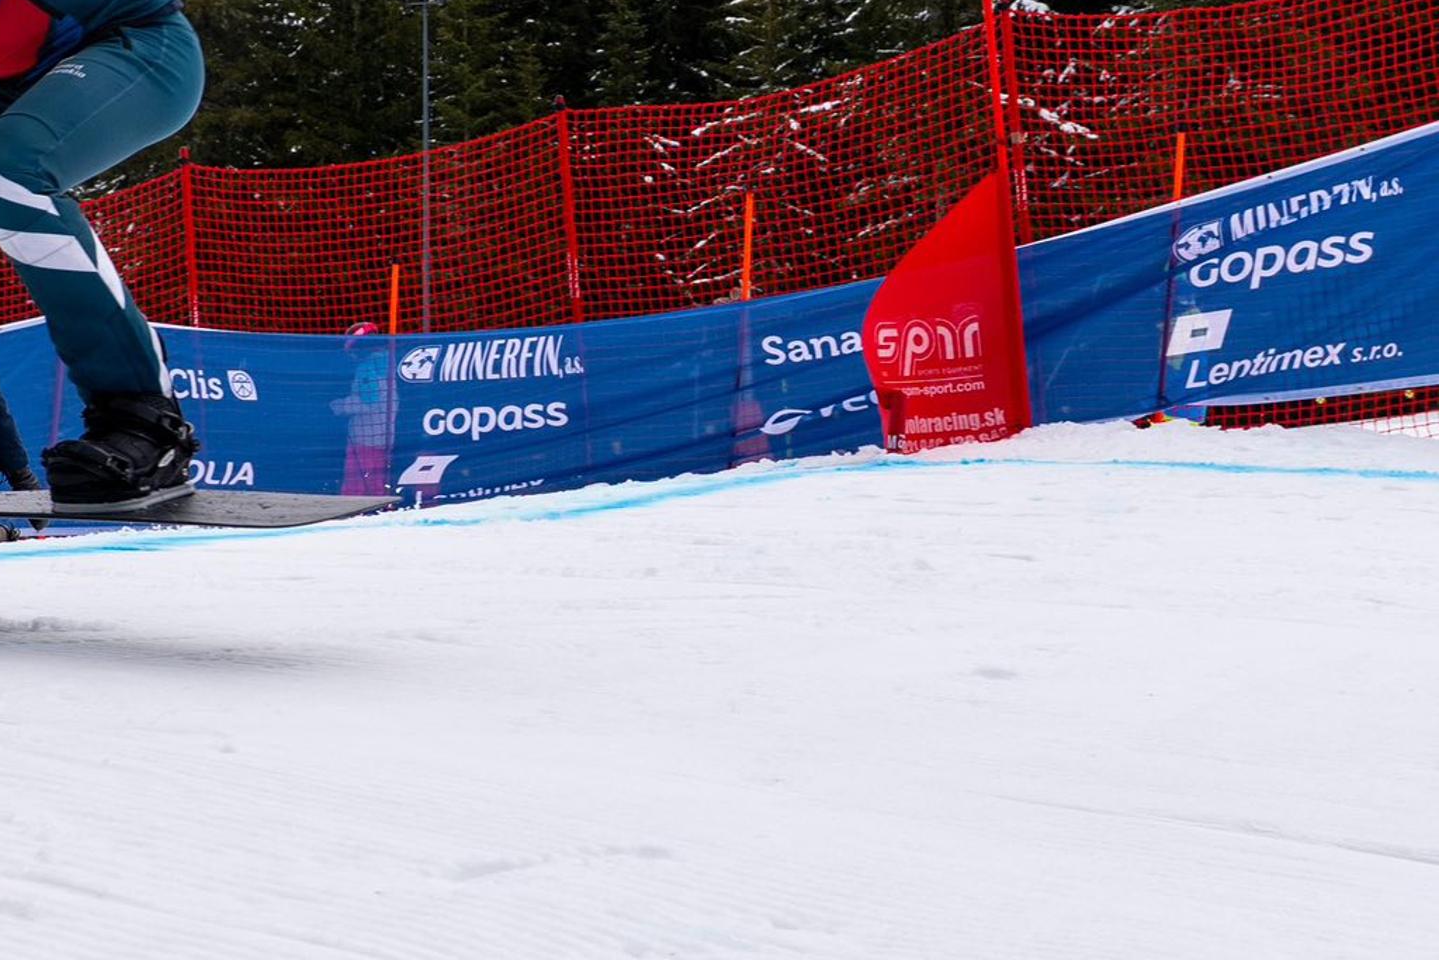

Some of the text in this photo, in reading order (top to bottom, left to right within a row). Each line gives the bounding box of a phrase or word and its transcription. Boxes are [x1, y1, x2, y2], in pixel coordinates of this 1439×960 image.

[761, 331, 864, 365] Sana
[1185, 342, 1404, 389] Lentimex s.r.o.
[168, 368, 224, 399] Clis
